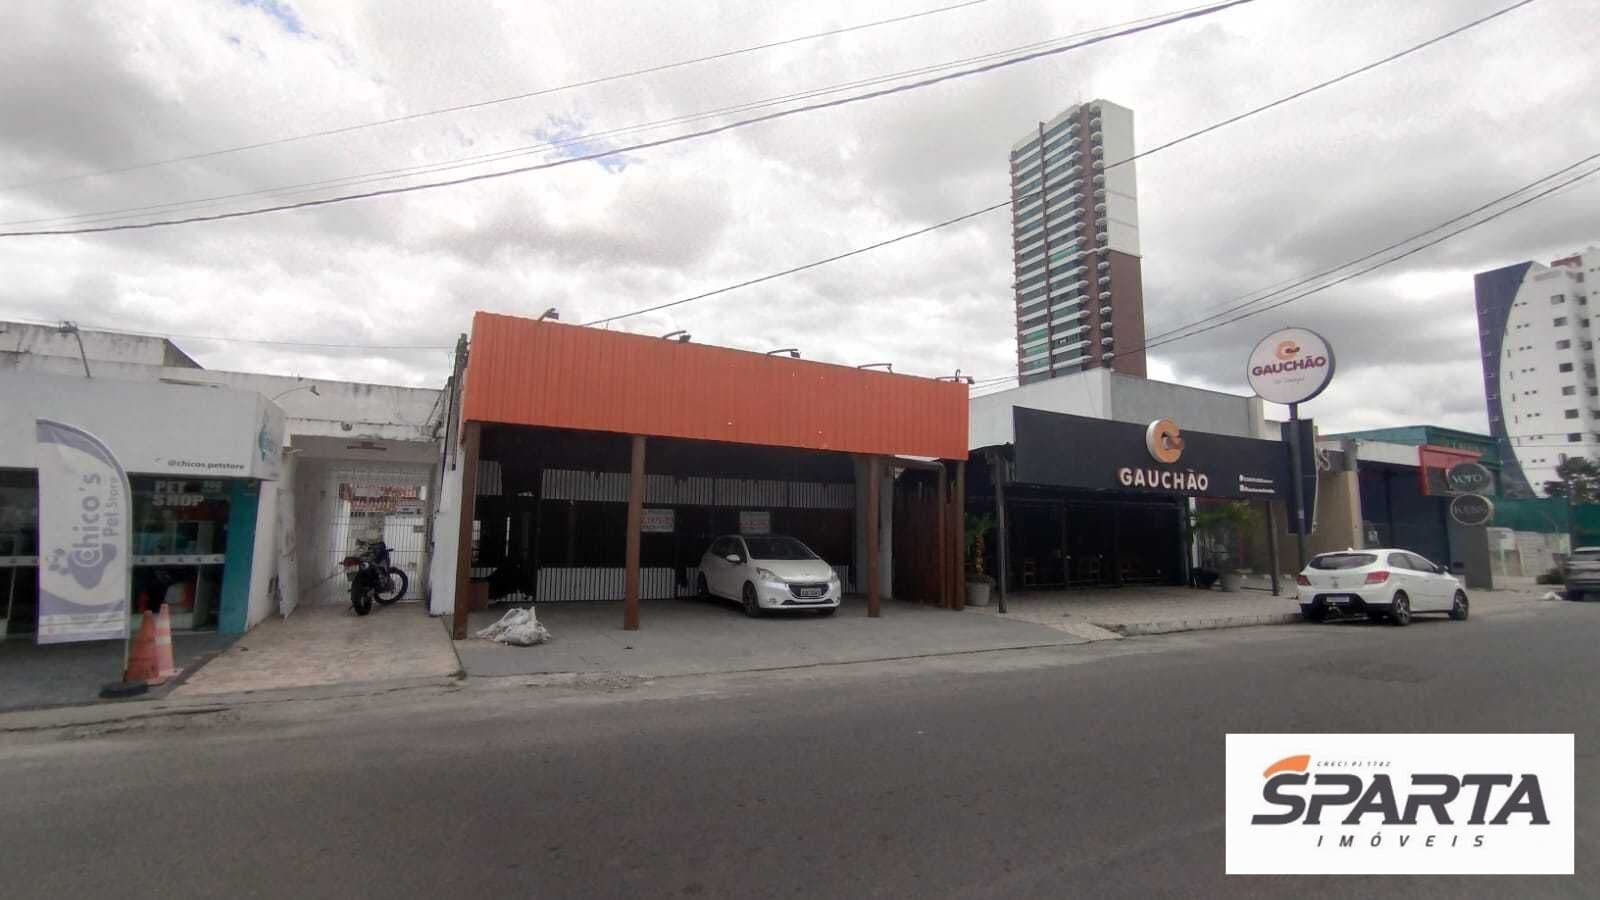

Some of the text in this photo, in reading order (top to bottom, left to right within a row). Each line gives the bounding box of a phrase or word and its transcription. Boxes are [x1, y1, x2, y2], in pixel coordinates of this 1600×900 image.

[1252, 356, 1326, 376] GAUCHÃO
[154, 480, 187, 494] PET
[1119, 467, 1208, 491] GAUCHÃO
[151, 494, 205, 507] SHOP
[103, 512, 121, 536] Pet
